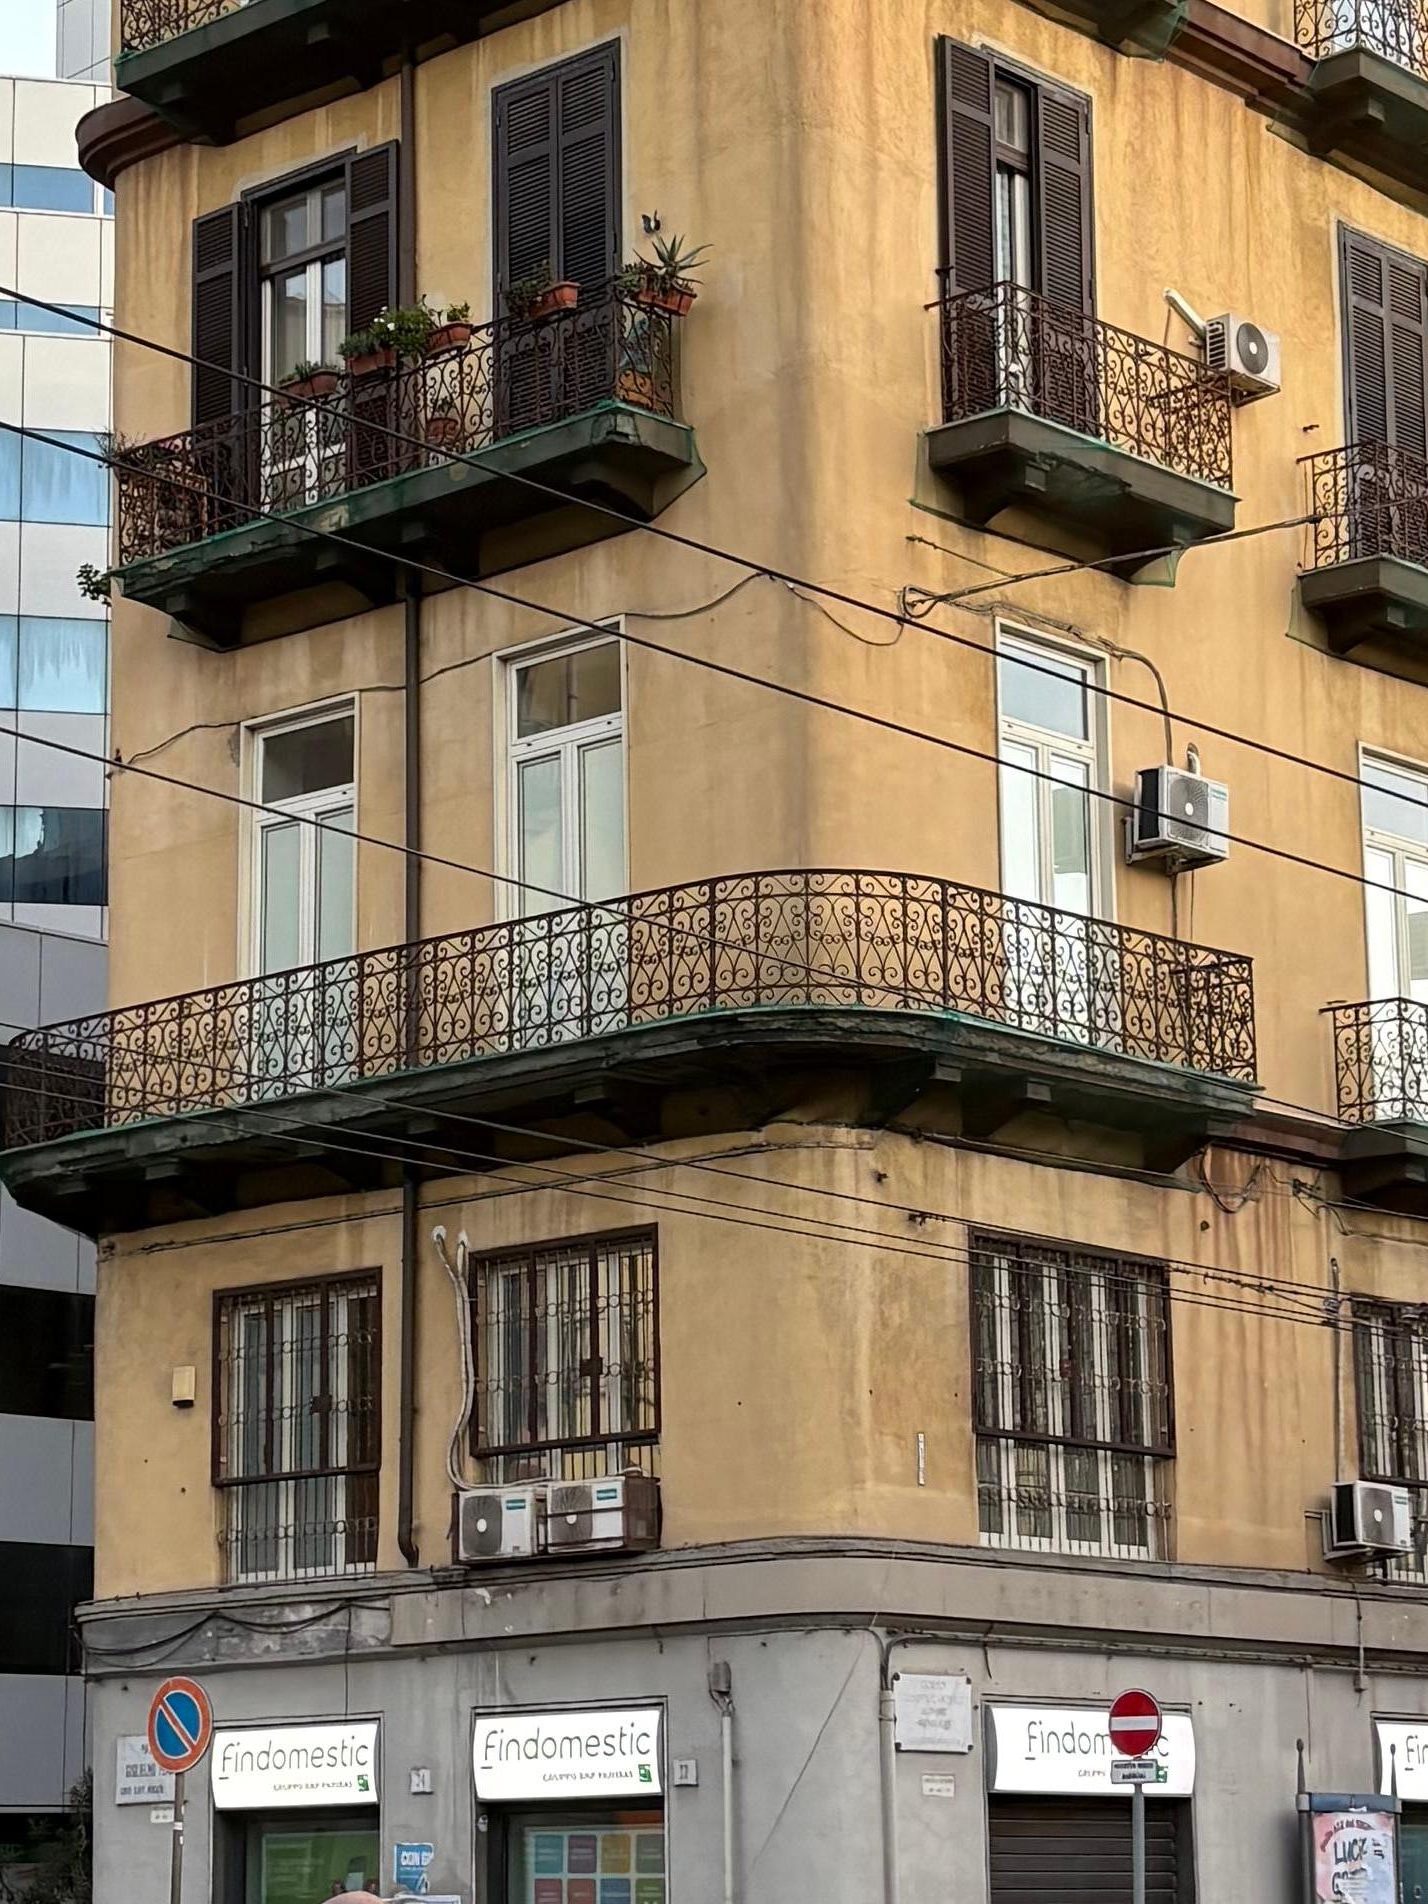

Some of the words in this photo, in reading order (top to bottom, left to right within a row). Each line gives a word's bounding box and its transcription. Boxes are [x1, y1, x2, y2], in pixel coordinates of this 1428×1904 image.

[221, 1735, 369, 1773] Findomestic
[484, 1722, 651, 1761] Findomestic
[1027, 1721, 1169, 1757] Findomc
